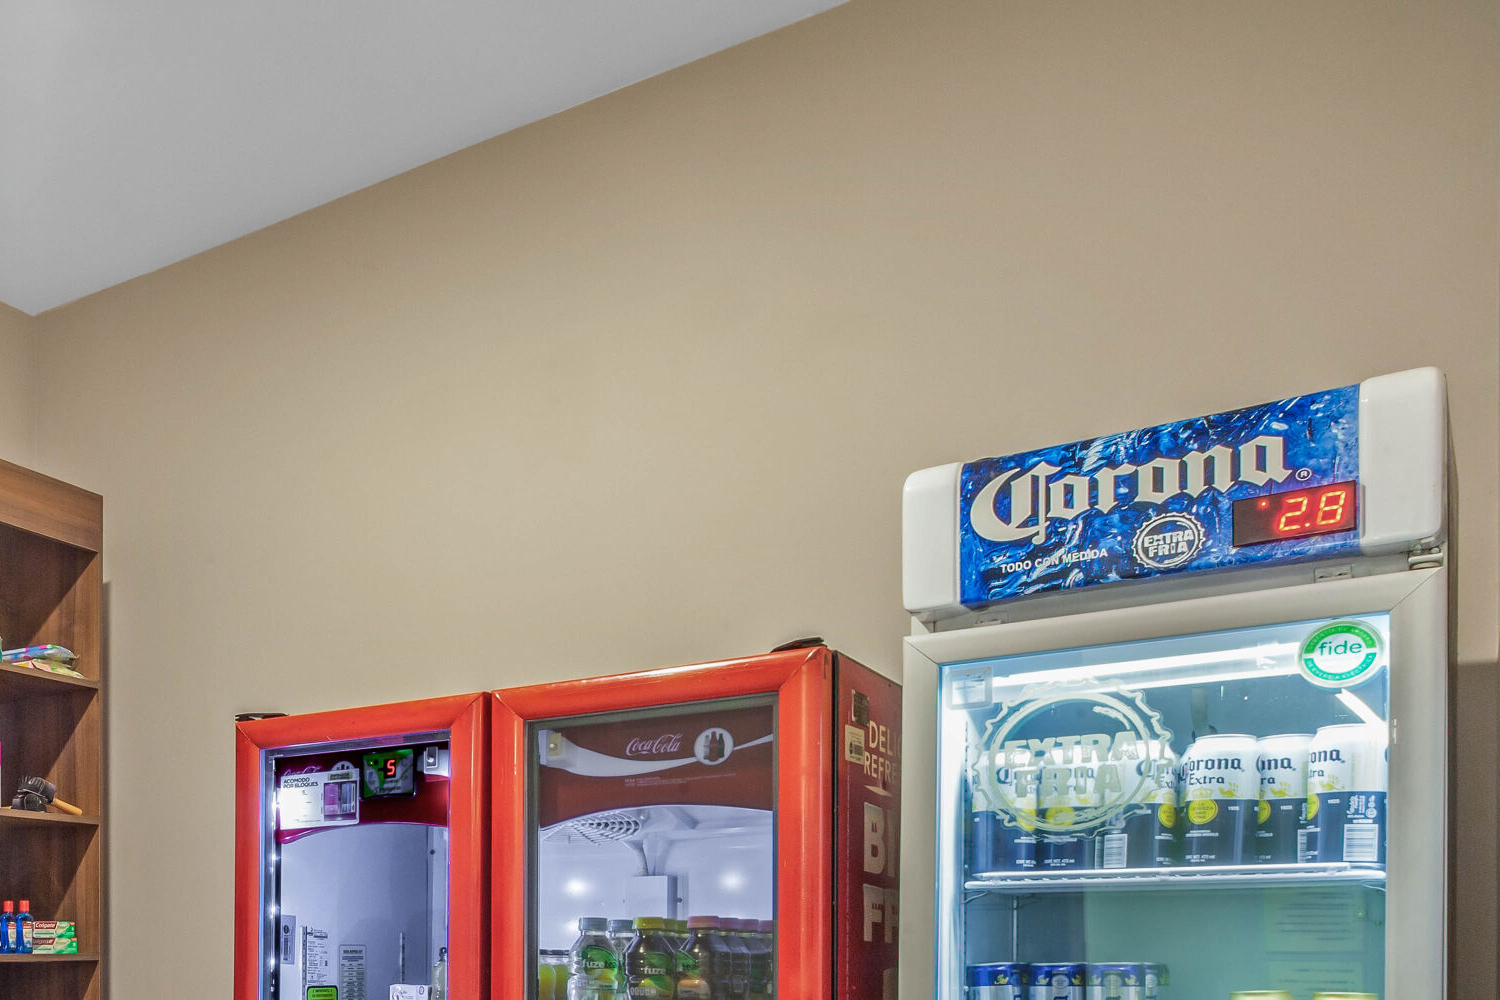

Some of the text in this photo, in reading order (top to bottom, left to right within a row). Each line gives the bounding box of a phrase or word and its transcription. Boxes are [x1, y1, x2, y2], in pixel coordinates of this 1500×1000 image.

[970, 435, 1292, 544] Corona
[1144, 530, 1194, 547] EXTRA
[1148, 543, 1189, 557] FRIA
[1000, 549, 1108, 573] TODO CON MEDIDA
[1318, 640, 1362, 656] fide
[626, 734, 683, 756] Coca-Cola
[1004, 731, 1139, 768] EXTRA
[1016, 765, 1122, 797] FRIA
[1189, 776, 1225, 785] Extra
[582, 960, 605, 970] fuze
[644, 966, 666, 975] fuze
